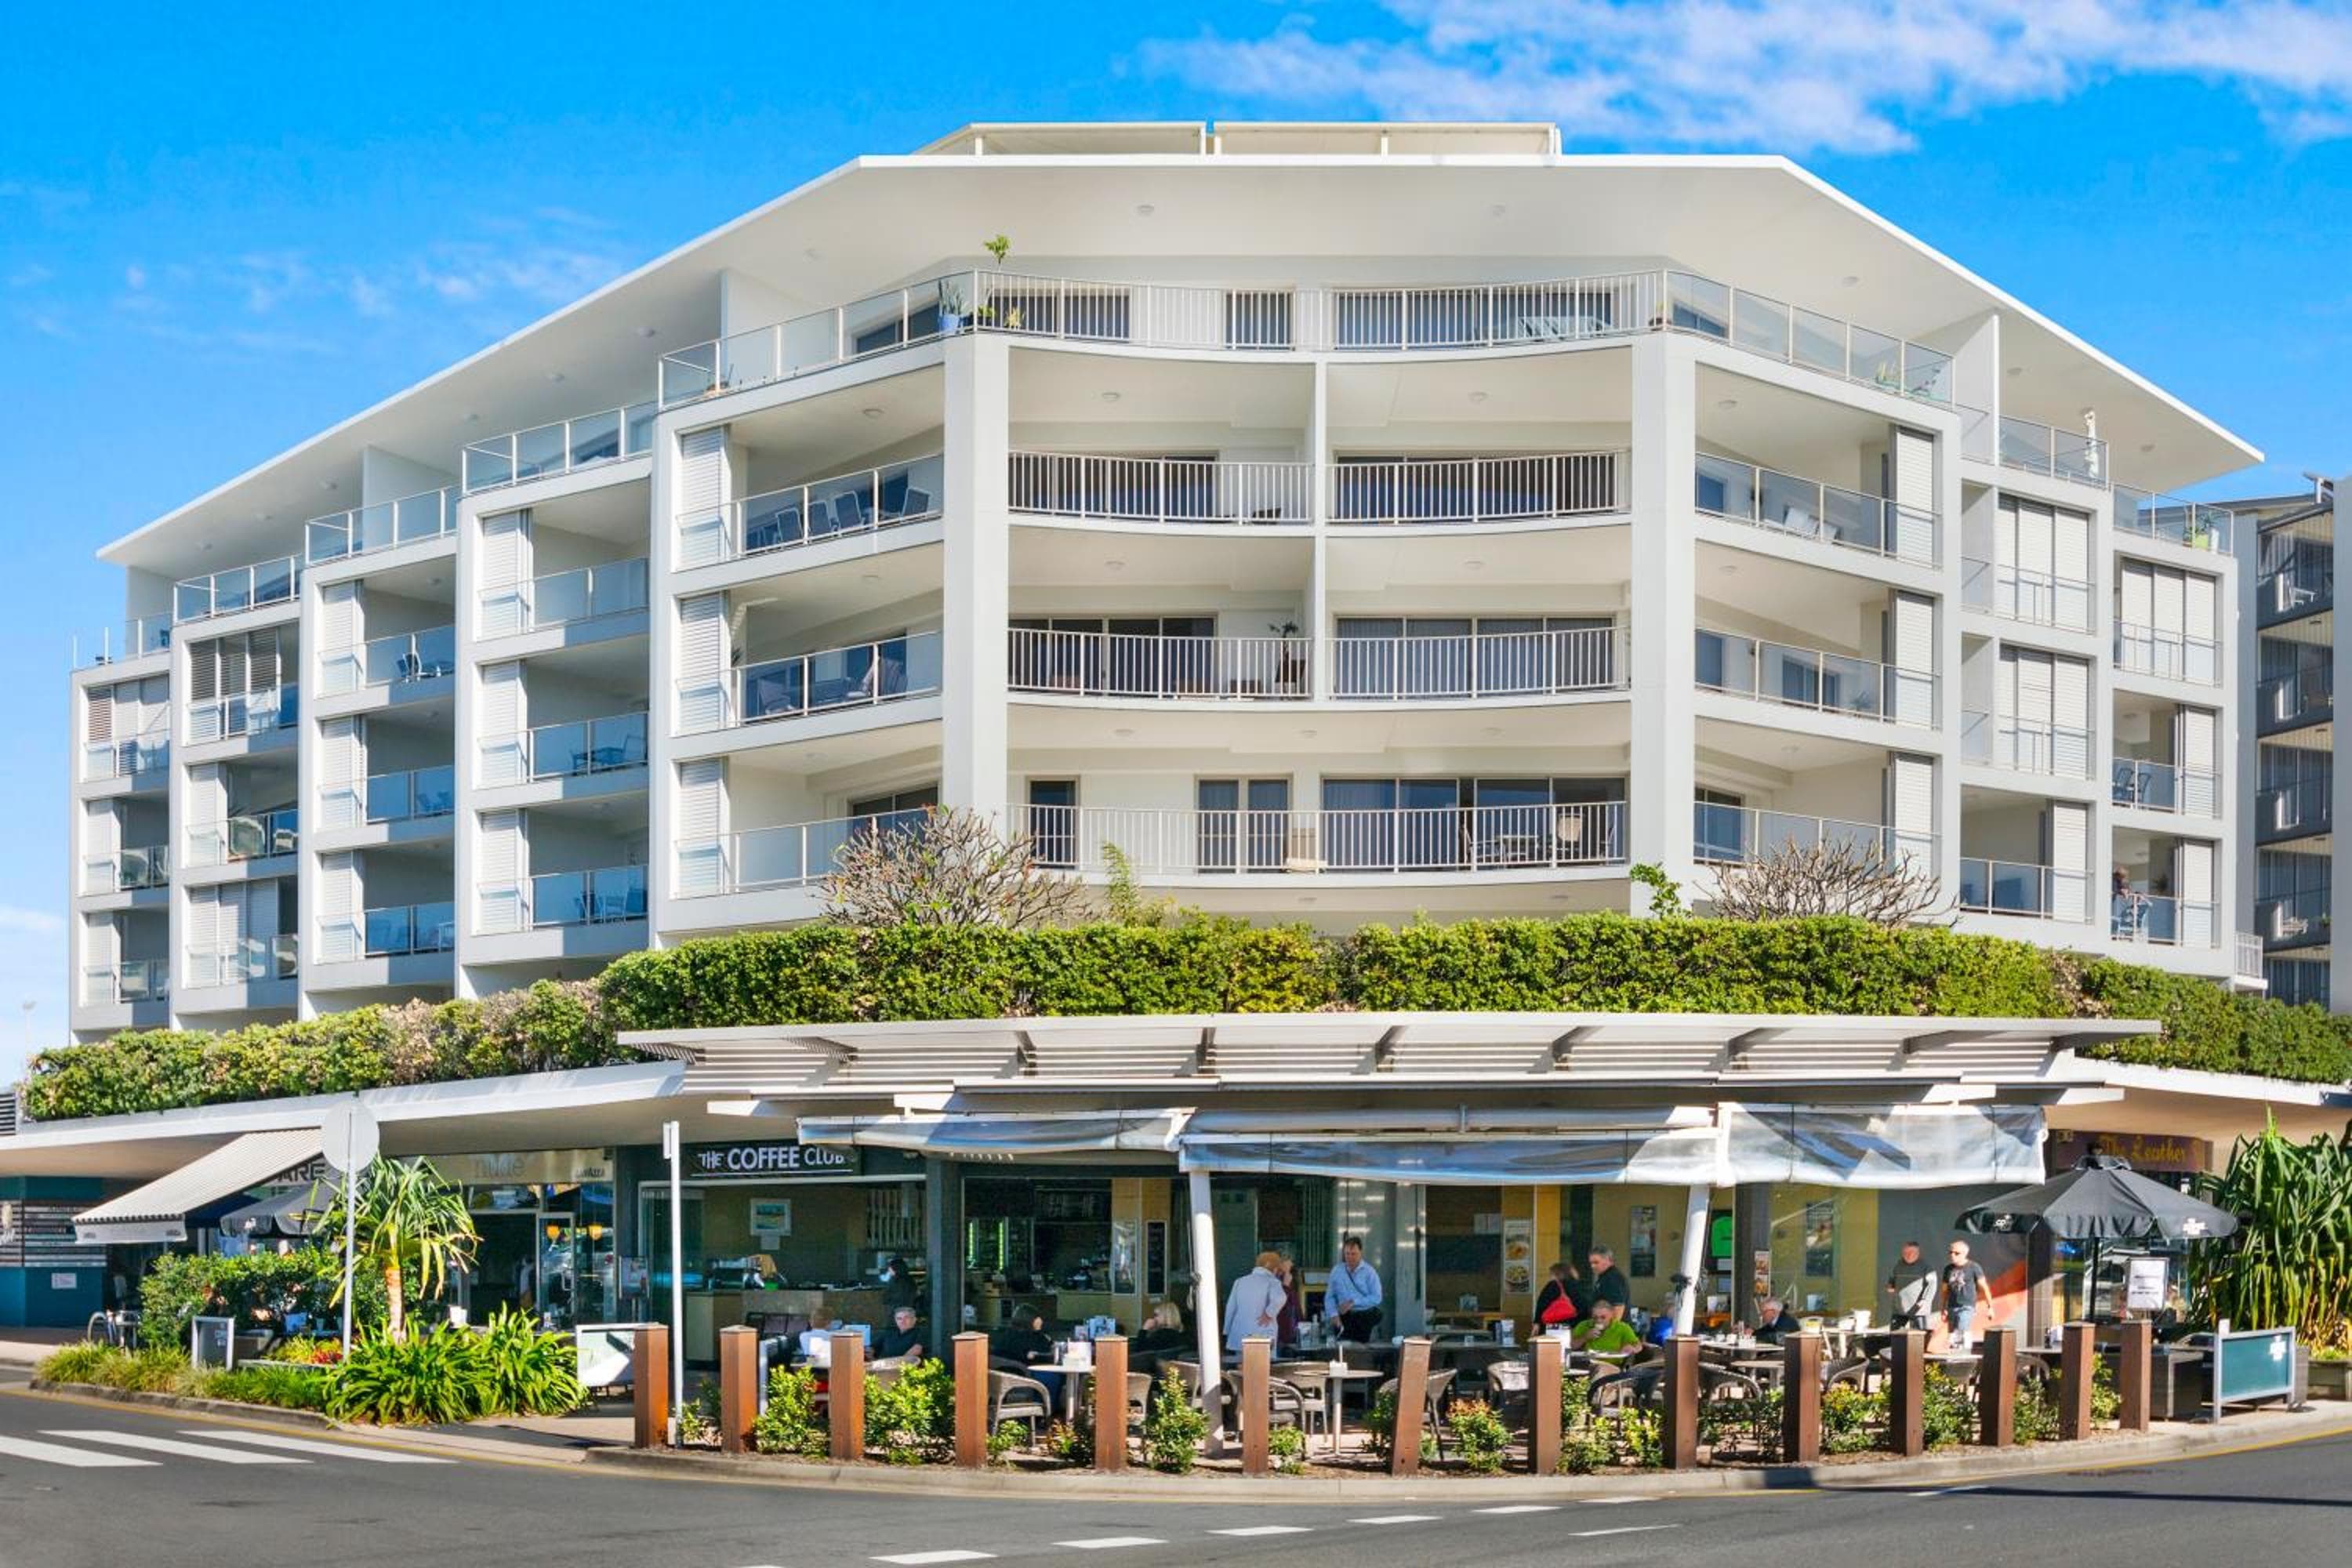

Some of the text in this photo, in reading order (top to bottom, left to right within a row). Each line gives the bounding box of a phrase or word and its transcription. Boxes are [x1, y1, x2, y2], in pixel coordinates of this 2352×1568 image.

[698, 1146, 845, 1171] THE COFFEE CLUB
[277, 1163, 326, 1181] ARE
